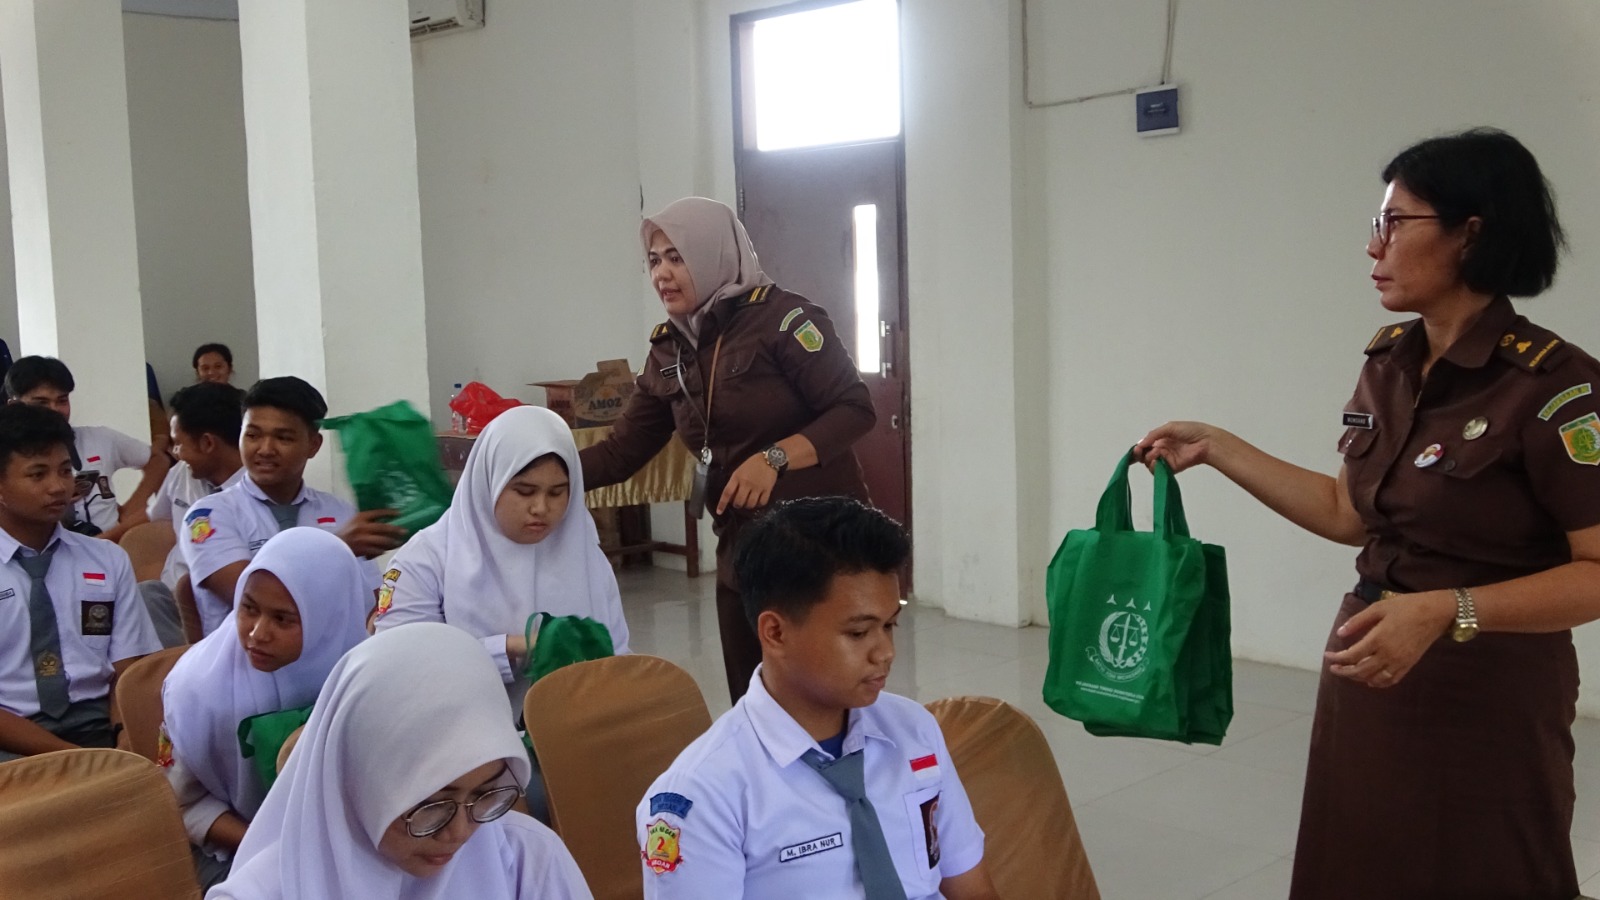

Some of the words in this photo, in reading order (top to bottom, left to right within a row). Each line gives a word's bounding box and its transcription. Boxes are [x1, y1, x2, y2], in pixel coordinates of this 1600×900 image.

[588, 397, 622, 411] AMOZ
[656, 836, 665, 851] 2
[786, 848, 796, 857] M.
[798, 842, 818, 855] IBRA
[820, 837, 836, 848] NUR
